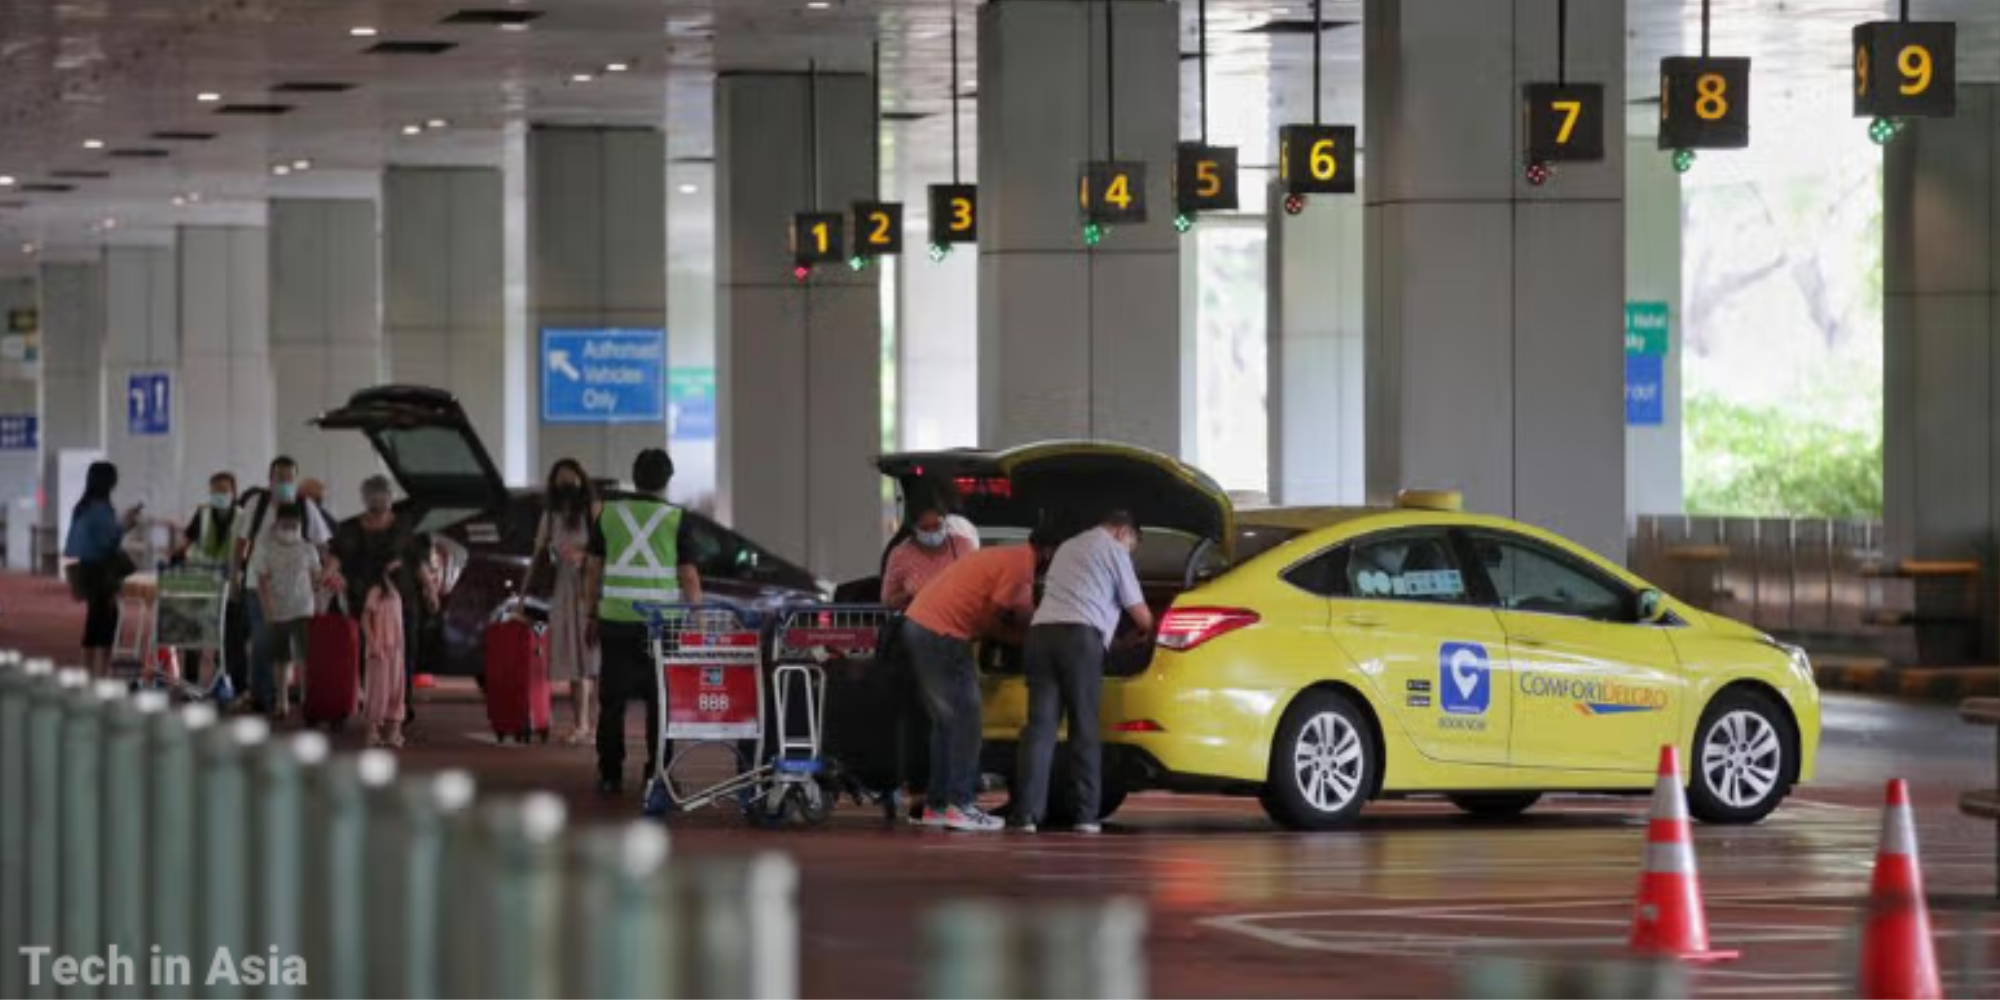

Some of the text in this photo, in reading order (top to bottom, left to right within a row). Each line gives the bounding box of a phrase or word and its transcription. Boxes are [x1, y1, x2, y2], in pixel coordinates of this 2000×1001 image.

[1897, 45, 1932, 95] 9
[1695, 73, 1728, 120] 8
[1551, 101, 1581, 143] 7
[1309, 138, 1337, 181] 6
[1104, 173, 1132, 210] 4
[1196, 160, 1221, 197] 5
[868, 211, 891, 244] 2
[951, 198, 972, 231] 3
[811, 222, 828, 253] 1
[582, 386, 618, 414] Only
